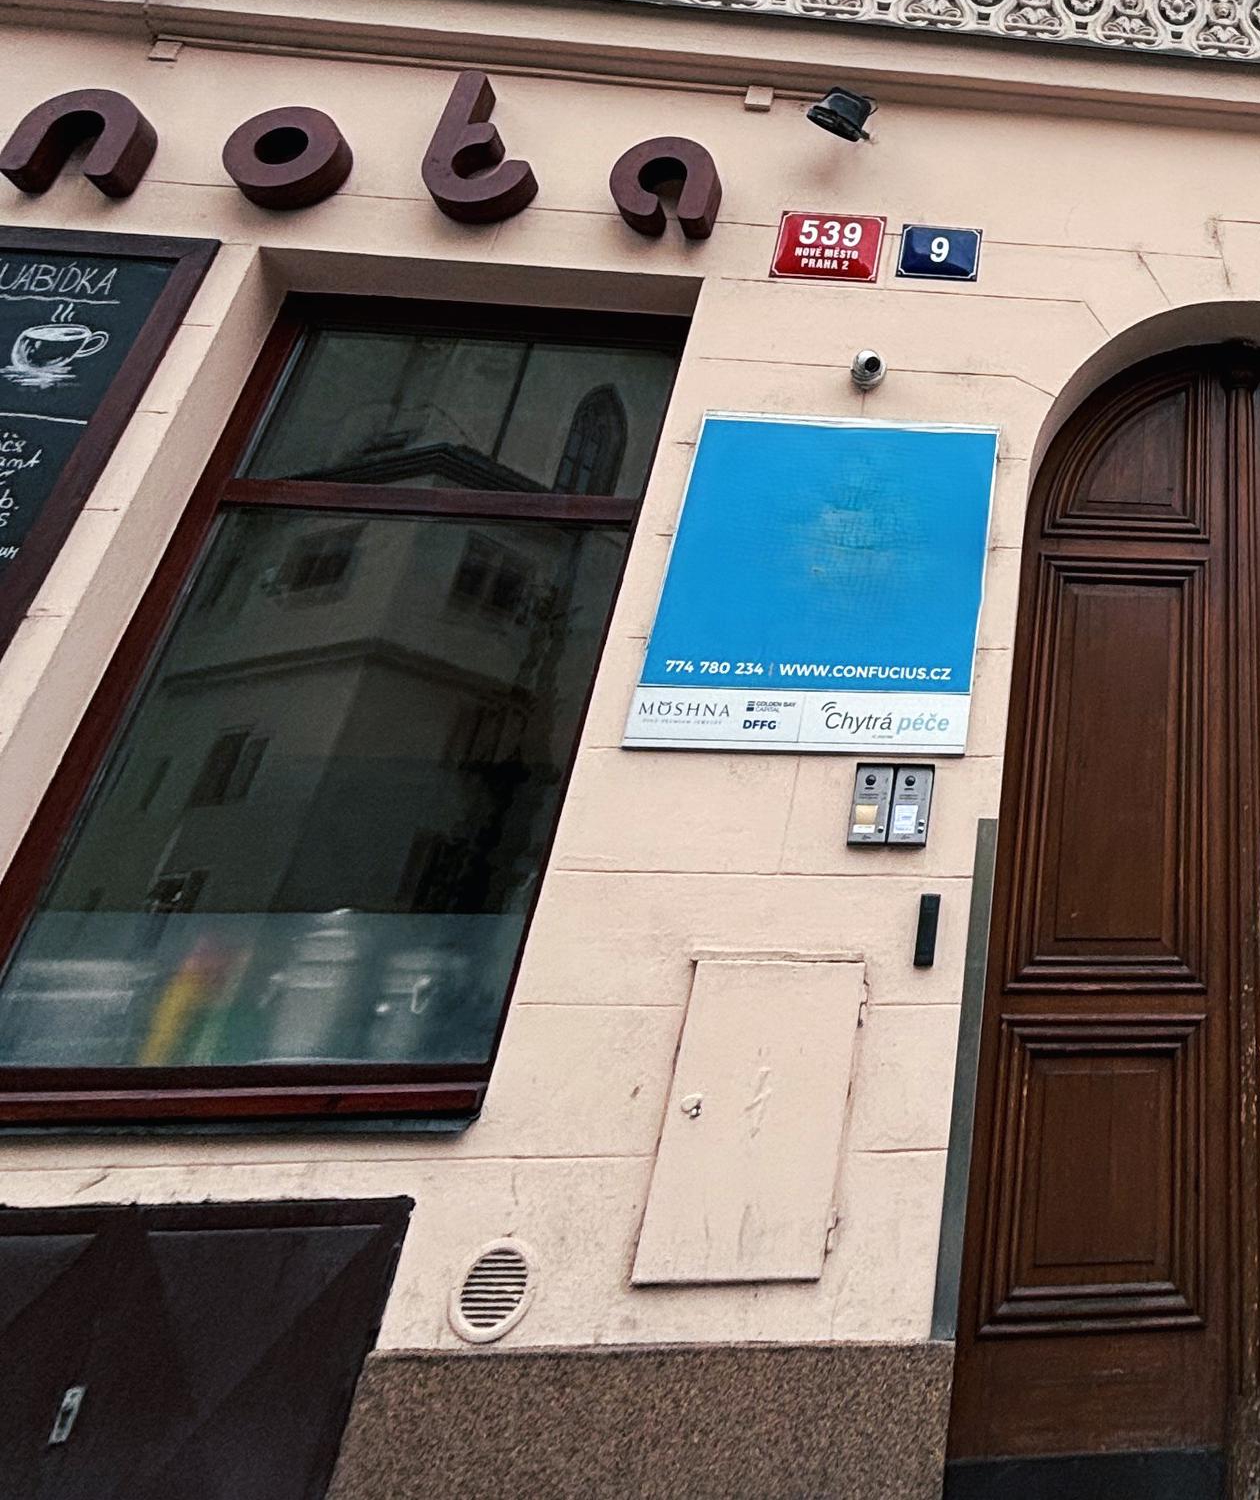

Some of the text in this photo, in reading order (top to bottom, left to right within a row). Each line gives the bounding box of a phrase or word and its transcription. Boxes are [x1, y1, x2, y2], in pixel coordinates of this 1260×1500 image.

[799, 220, 863, 247] 539
[794, 246, 859, 260] NOVÉ MĚSTO
[929, 237, 950, 263] 9
[801, 258, 849, 270] PRAHA 2
[665, 660, 952, 681] 774 780 234 WWW.CONFUCIUS.CZ
[742, 719, 777, 730] DFFG
[825, 712, 950, 735] Chytrá péče
